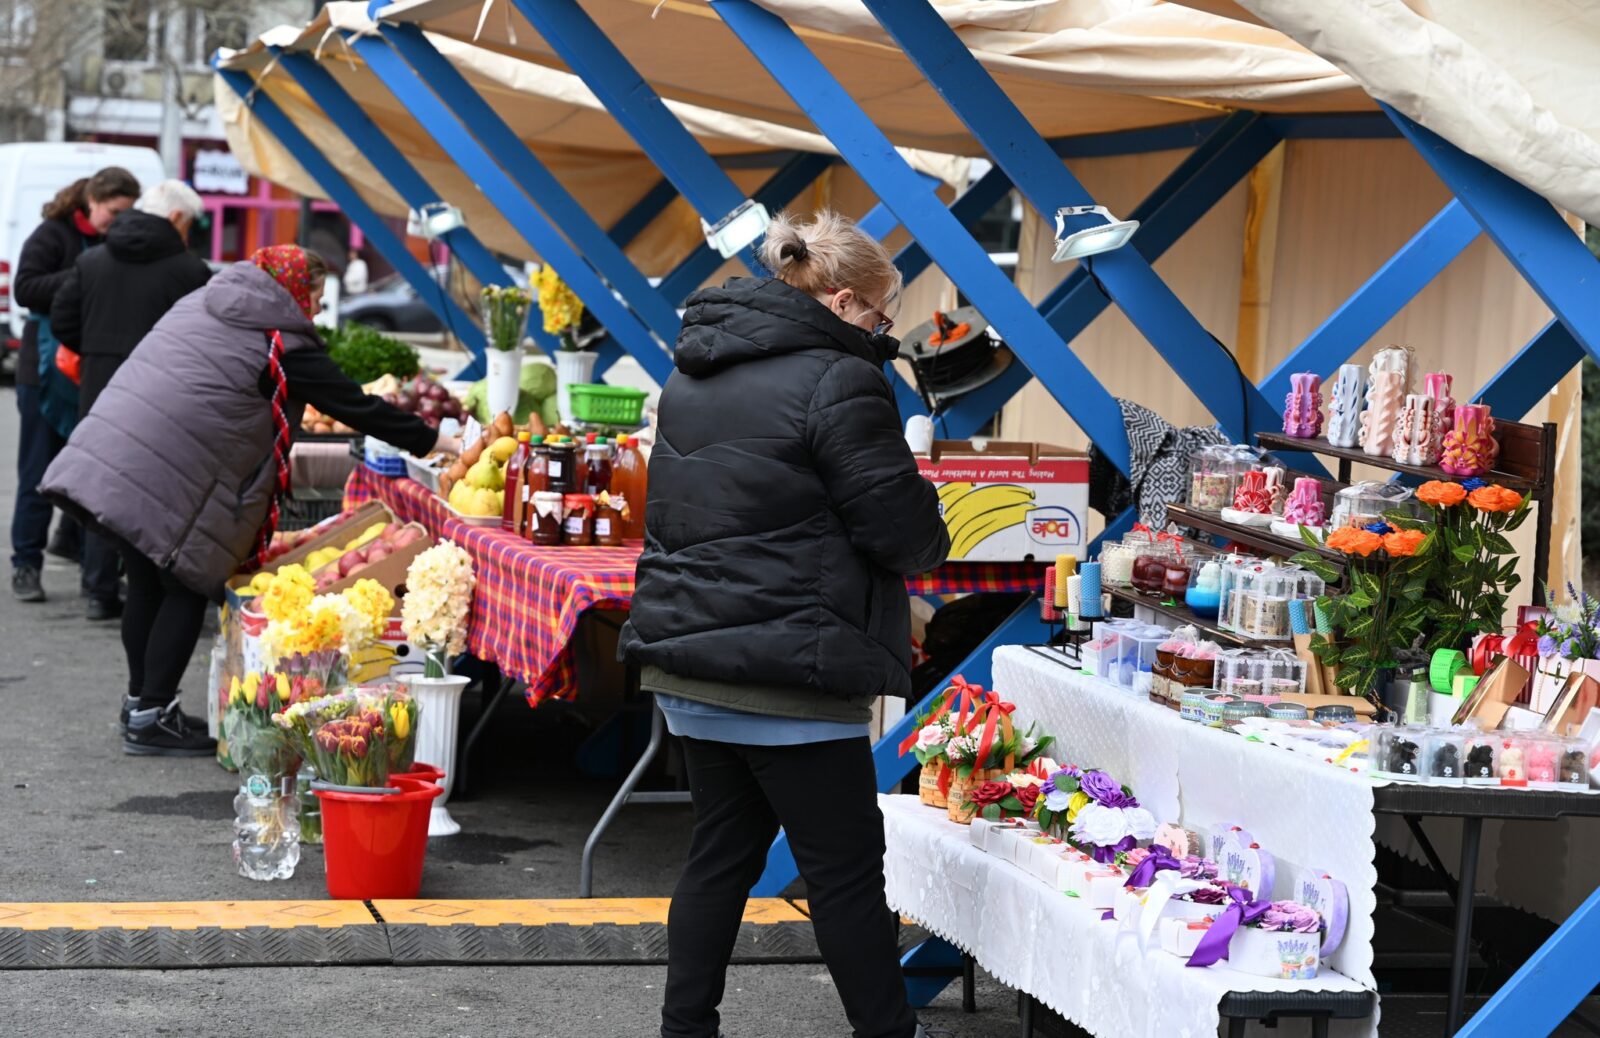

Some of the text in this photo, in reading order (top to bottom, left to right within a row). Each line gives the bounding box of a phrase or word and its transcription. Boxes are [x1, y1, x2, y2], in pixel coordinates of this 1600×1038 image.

[941, 470, 977, 479] Healthier
[980, 470, 986, 479] A
[988, 470, 1009, 479] World
[1011, 470, 1025, 479] The
[1028, 468, 1055, 479] Making
[1032, 521, 1069, 538] Dole
